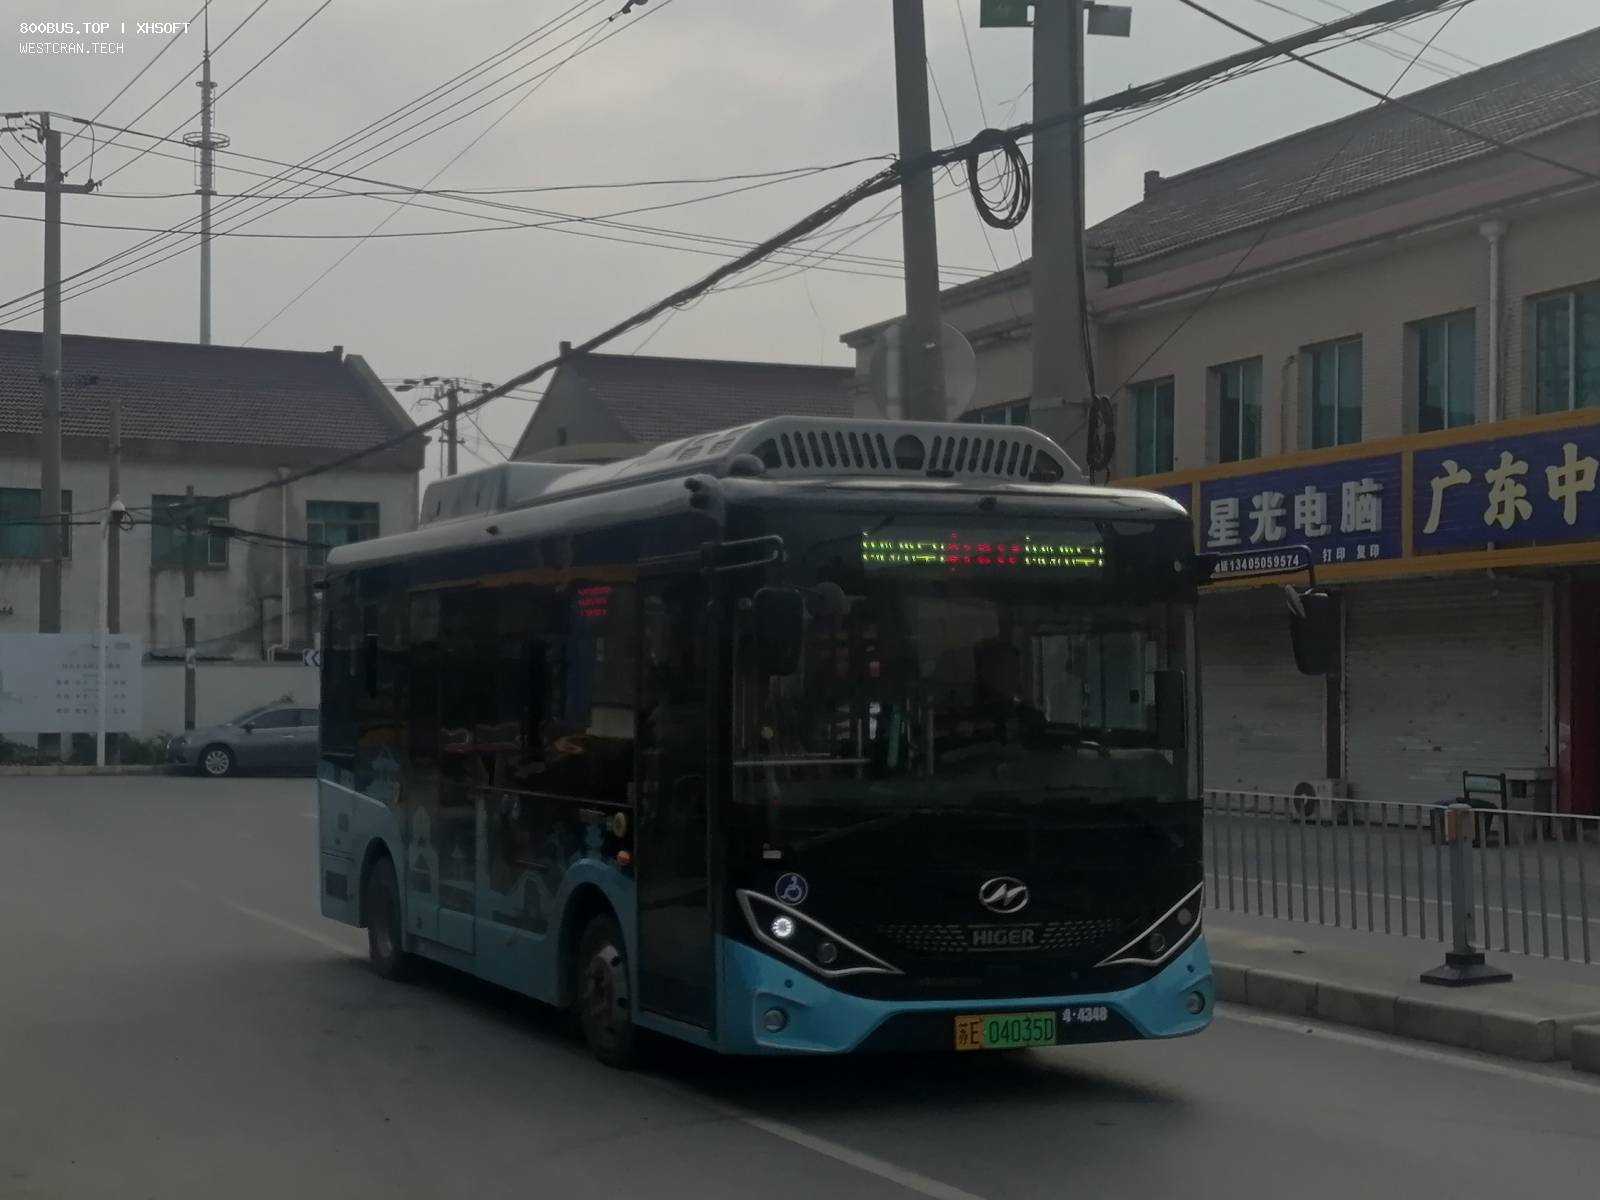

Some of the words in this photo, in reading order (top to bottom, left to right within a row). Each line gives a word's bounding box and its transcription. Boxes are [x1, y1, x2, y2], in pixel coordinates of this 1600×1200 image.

[1206, 478, 1385, 548] 星光电脑
[1322, 547, 1346, 563] 打印
[972, 928, 1035, 946] HIGER
